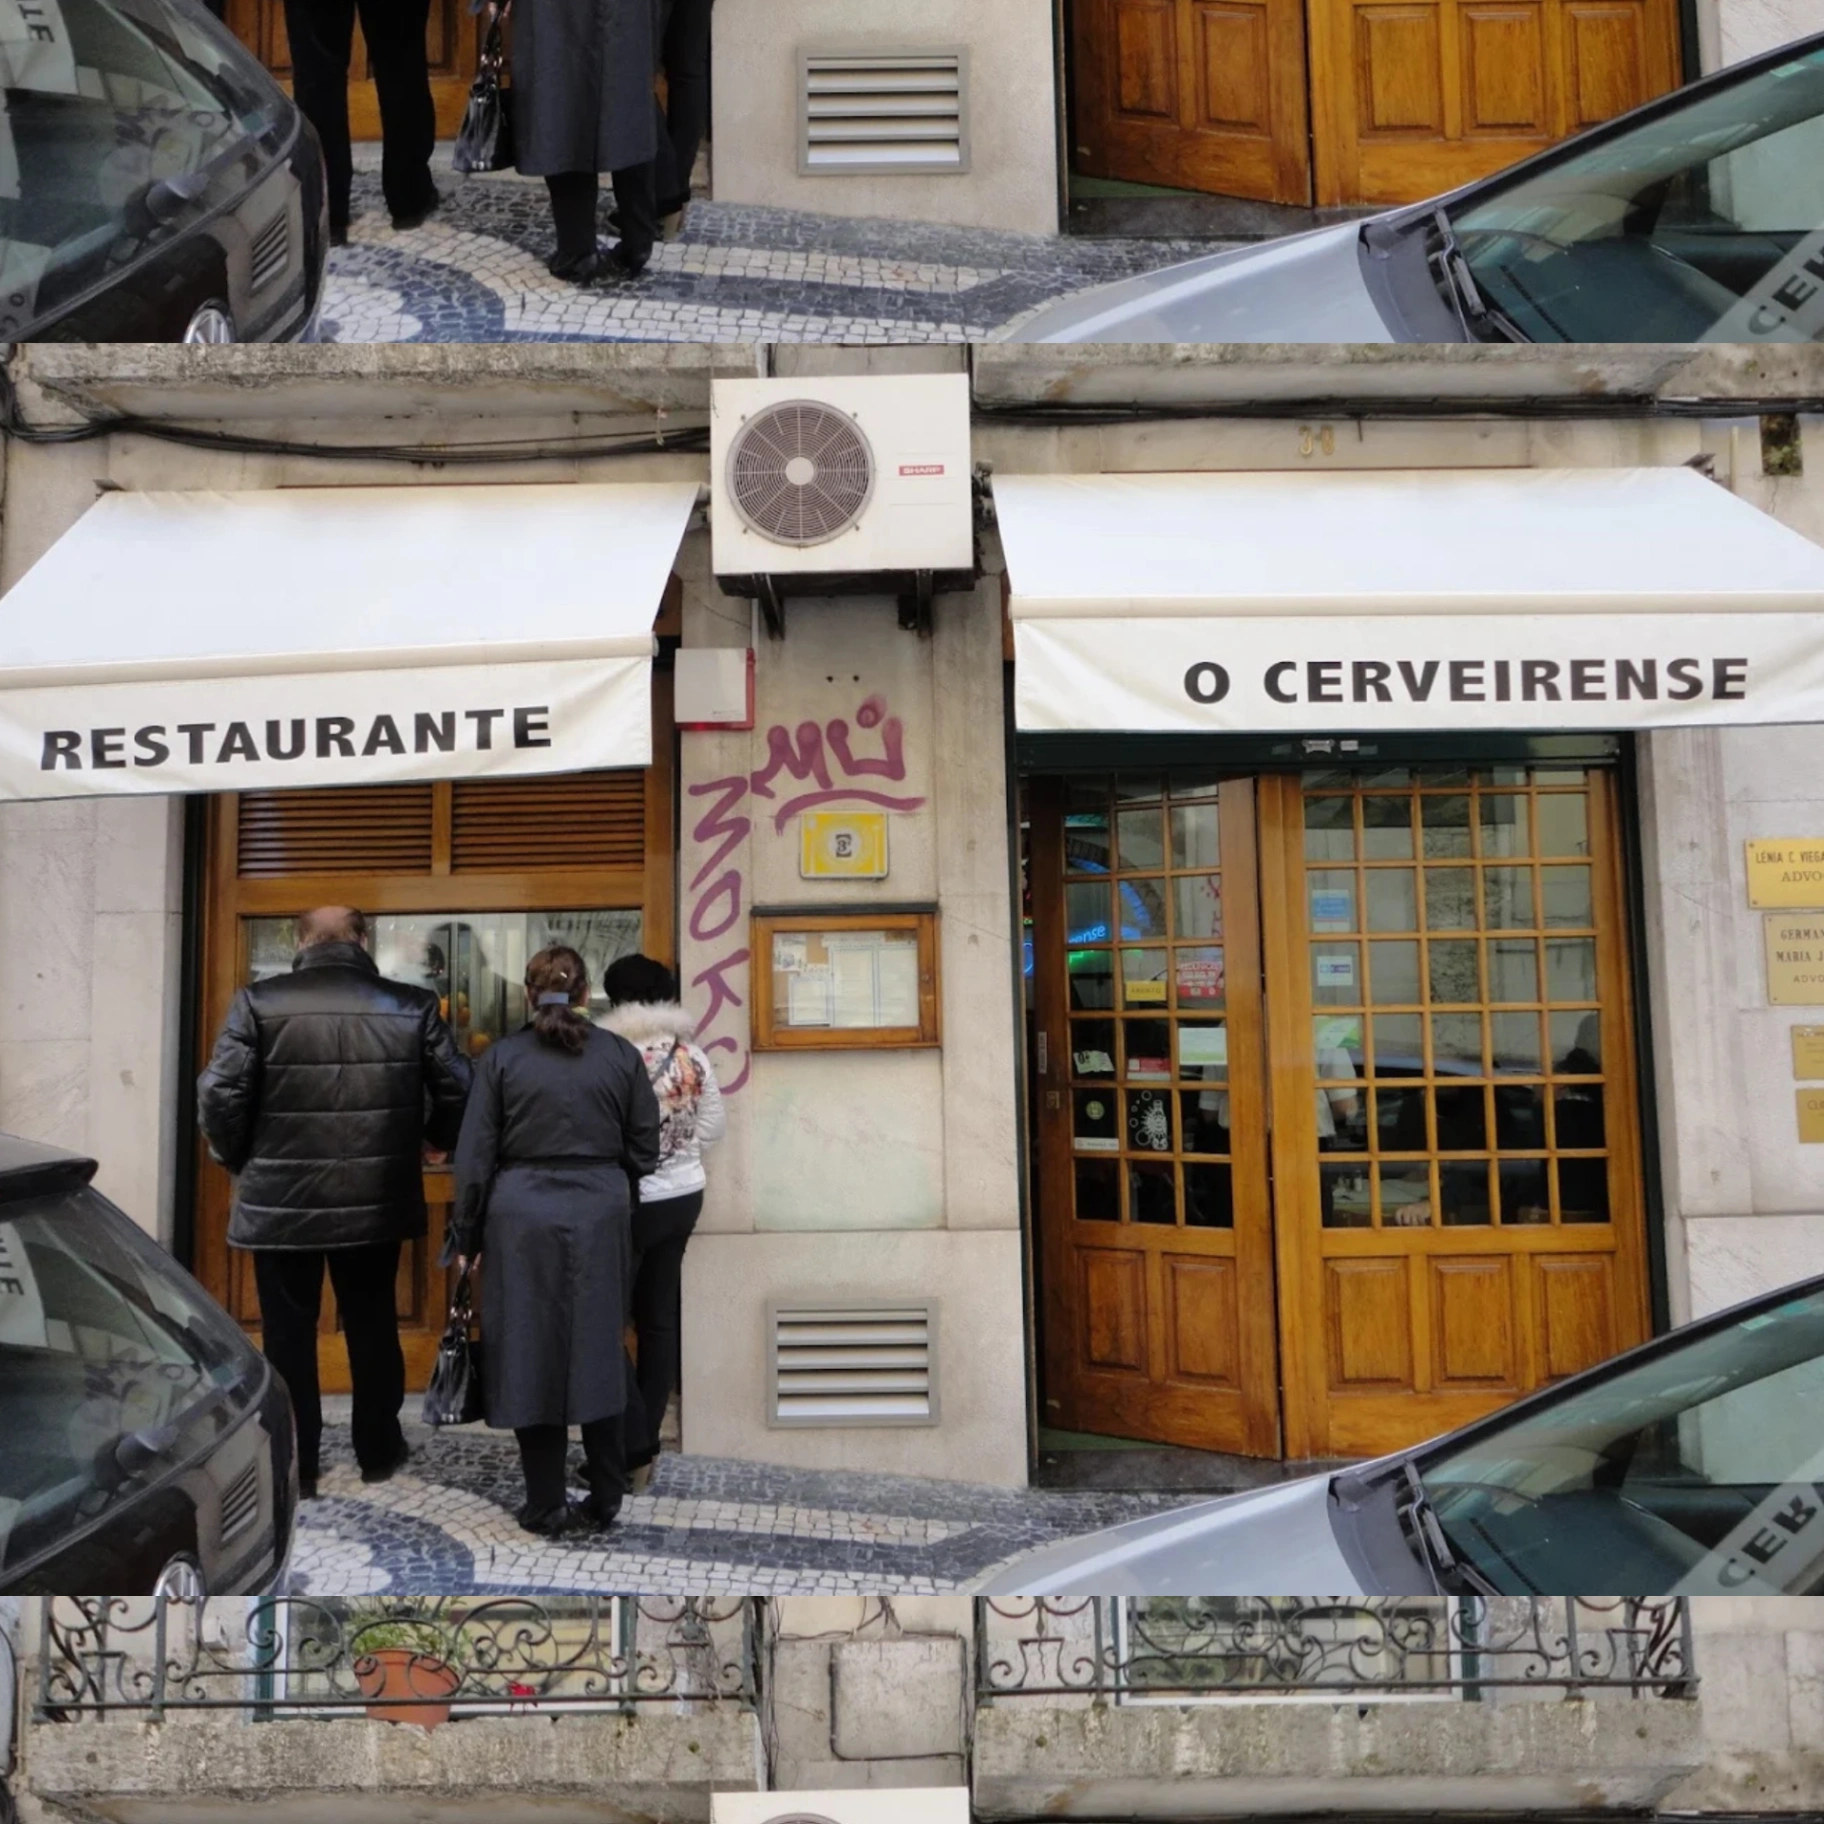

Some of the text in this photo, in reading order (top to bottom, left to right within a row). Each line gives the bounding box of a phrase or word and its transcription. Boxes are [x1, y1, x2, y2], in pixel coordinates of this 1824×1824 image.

[901, 466, 942, 474] SHARP
[1185, 659, 1748, 703] O CERVEIRENSE
[42, 707, 551, 770] RESTAURANTE
[1776, 950, 1811, 962] MARIA
